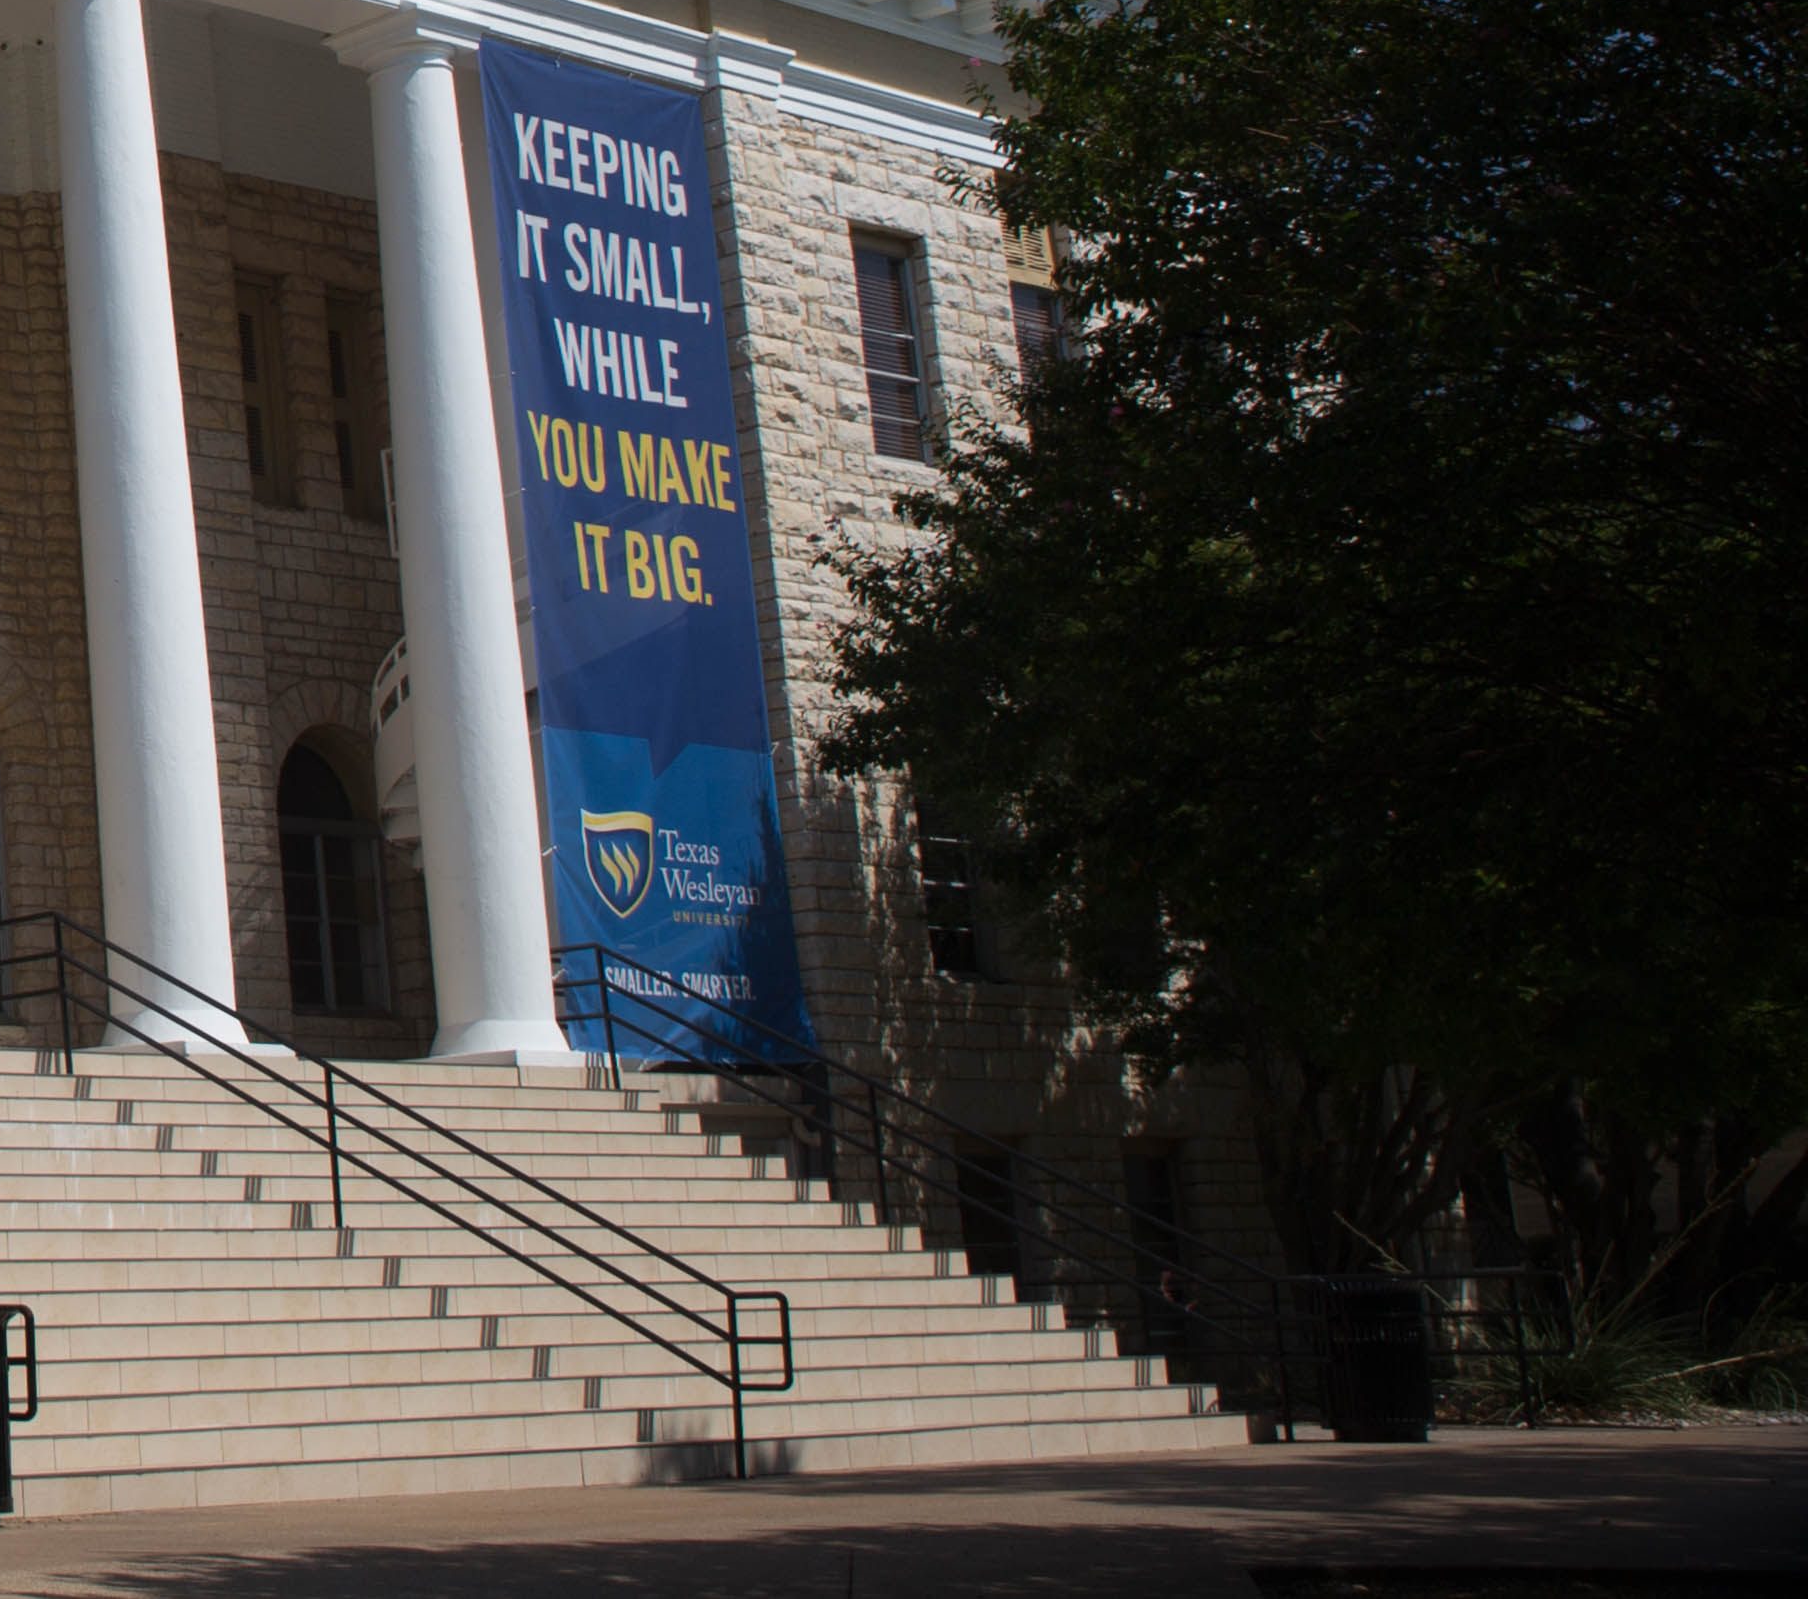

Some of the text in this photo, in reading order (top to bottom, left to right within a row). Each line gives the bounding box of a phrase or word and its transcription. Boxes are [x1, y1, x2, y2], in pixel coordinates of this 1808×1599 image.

[513, 112, 688, 217] KEEPING
[516, 209, 711, 325] IT SMALL,
[553, 317, 688, 408] WHILE
[526, 409, 737, 513] YOU MAKE
[573, 521, 714, 607] IT BIG.
[658, 829, 719, 865] Texas
[659, 867, 761, 912] Wesleyan
